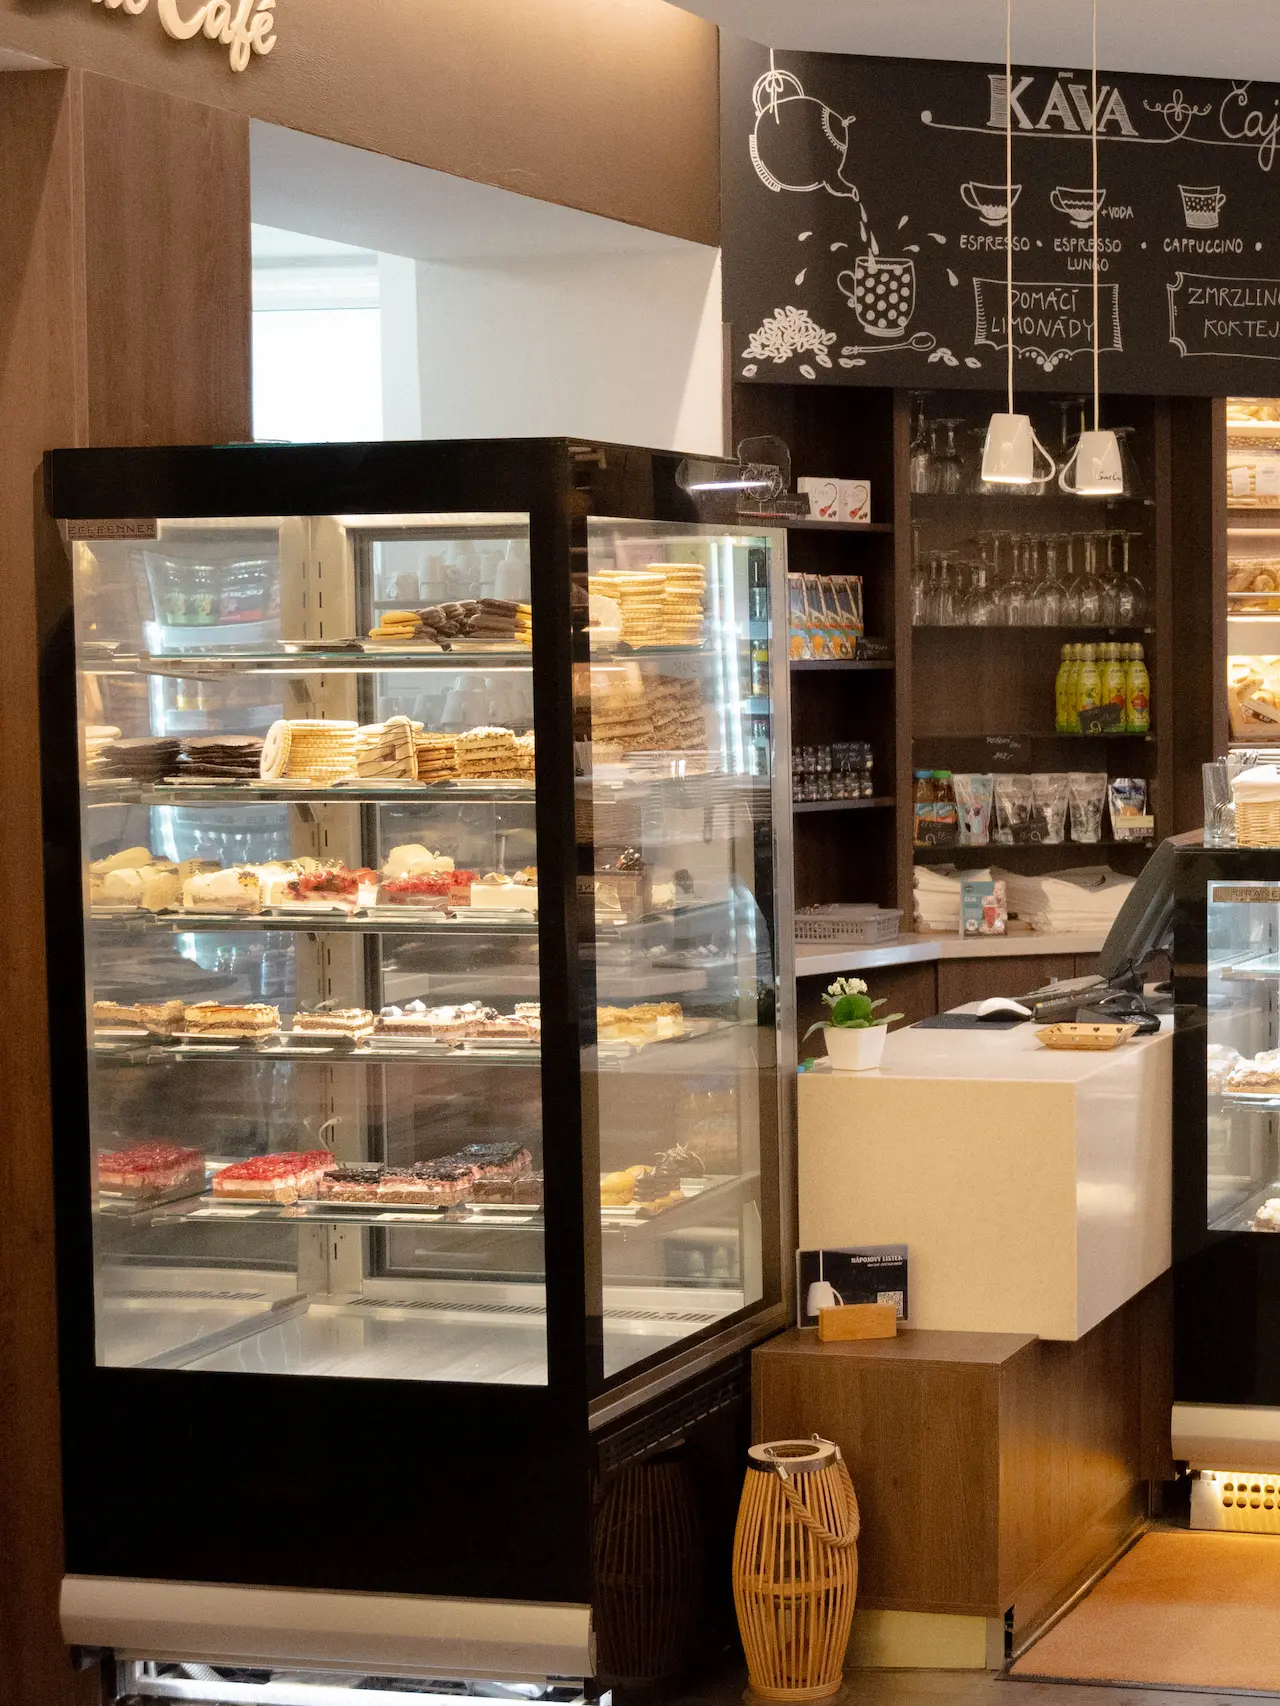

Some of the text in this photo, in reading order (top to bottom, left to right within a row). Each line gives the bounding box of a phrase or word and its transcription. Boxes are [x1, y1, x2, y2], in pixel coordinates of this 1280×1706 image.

[959, 234, 1031, 251] ESPRESSO
[1053, 237, 1122, 254] ESPRESSO
[1163, 237, 1244, 253] CAPPUCCINO
